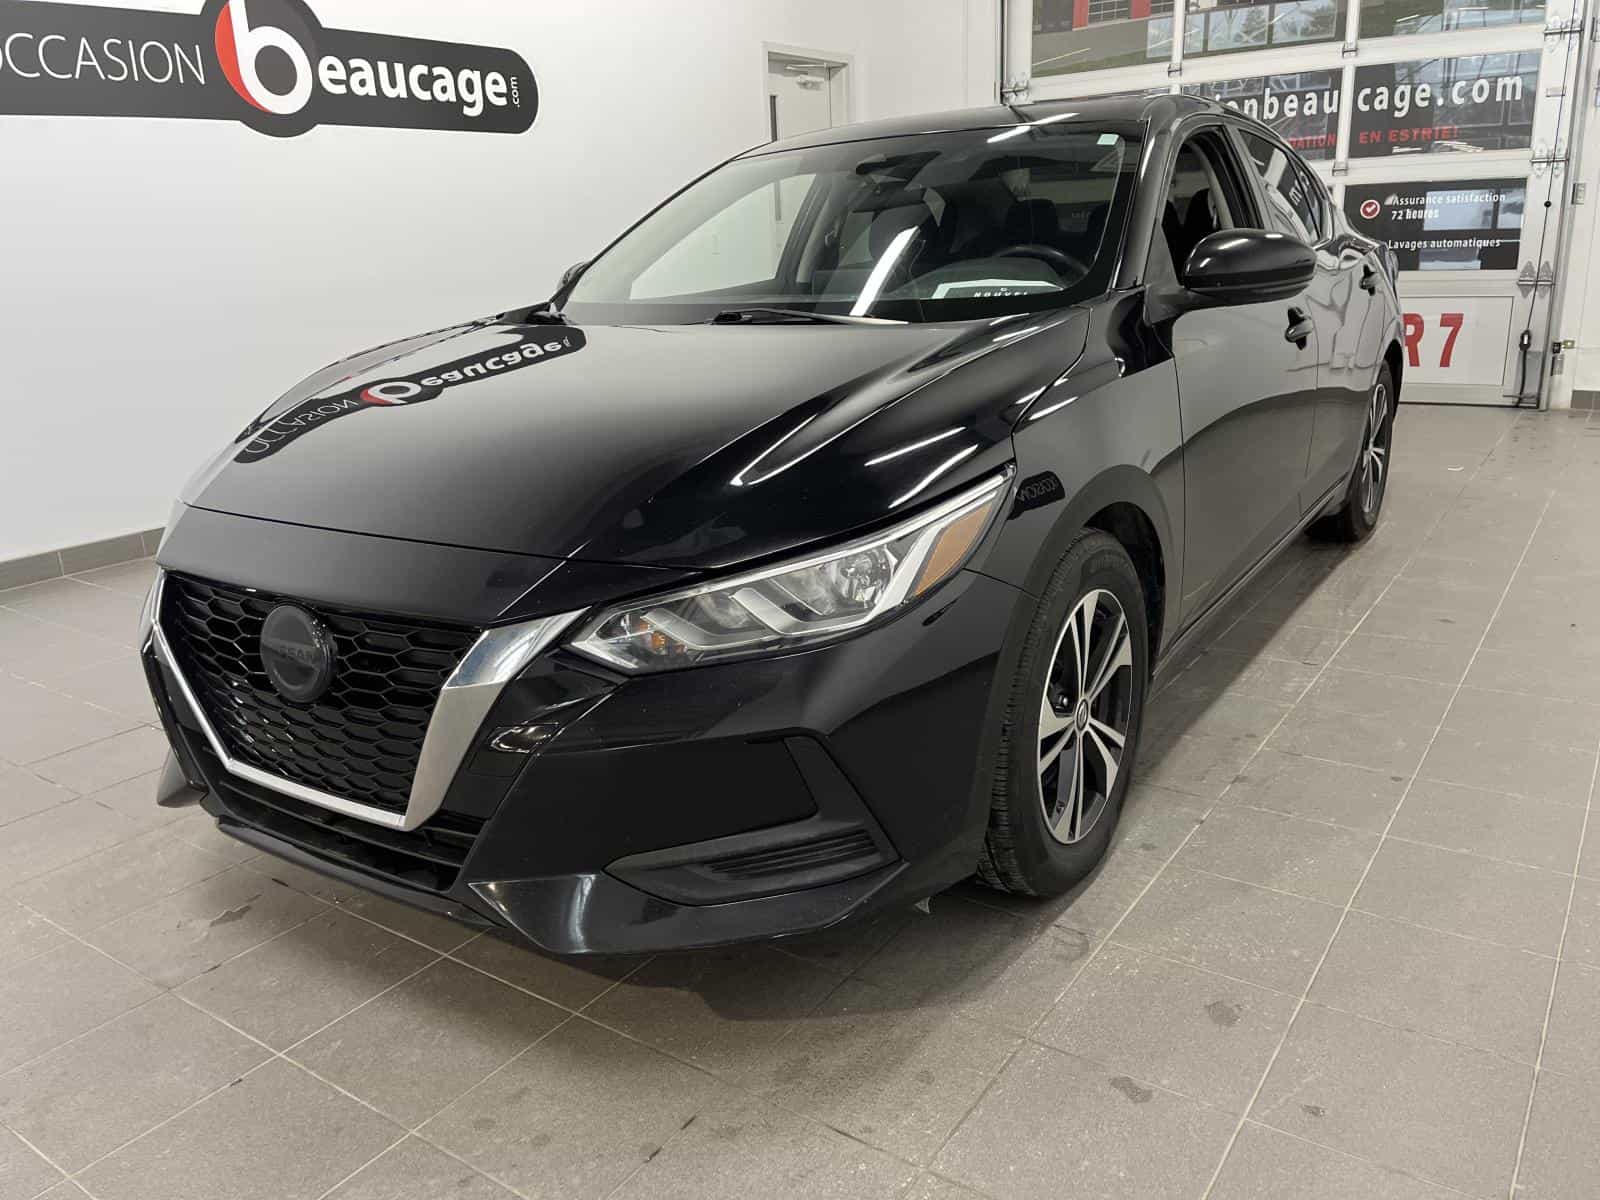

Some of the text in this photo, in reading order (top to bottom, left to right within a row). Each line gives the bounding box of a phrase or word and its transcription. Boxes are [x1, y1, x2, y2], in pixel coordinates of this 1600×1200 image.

[0, 32, 206, 85] CCASION
[1359, 131, 1383, 144] EN
[1392, 191, 1506, 206] Assurance satisfaction
[1391, 208, 1440, 220] 72 heures
[1388, 237, 1501, 251] Lavages automatiques
[1439, 313, 1464, 368] 7
